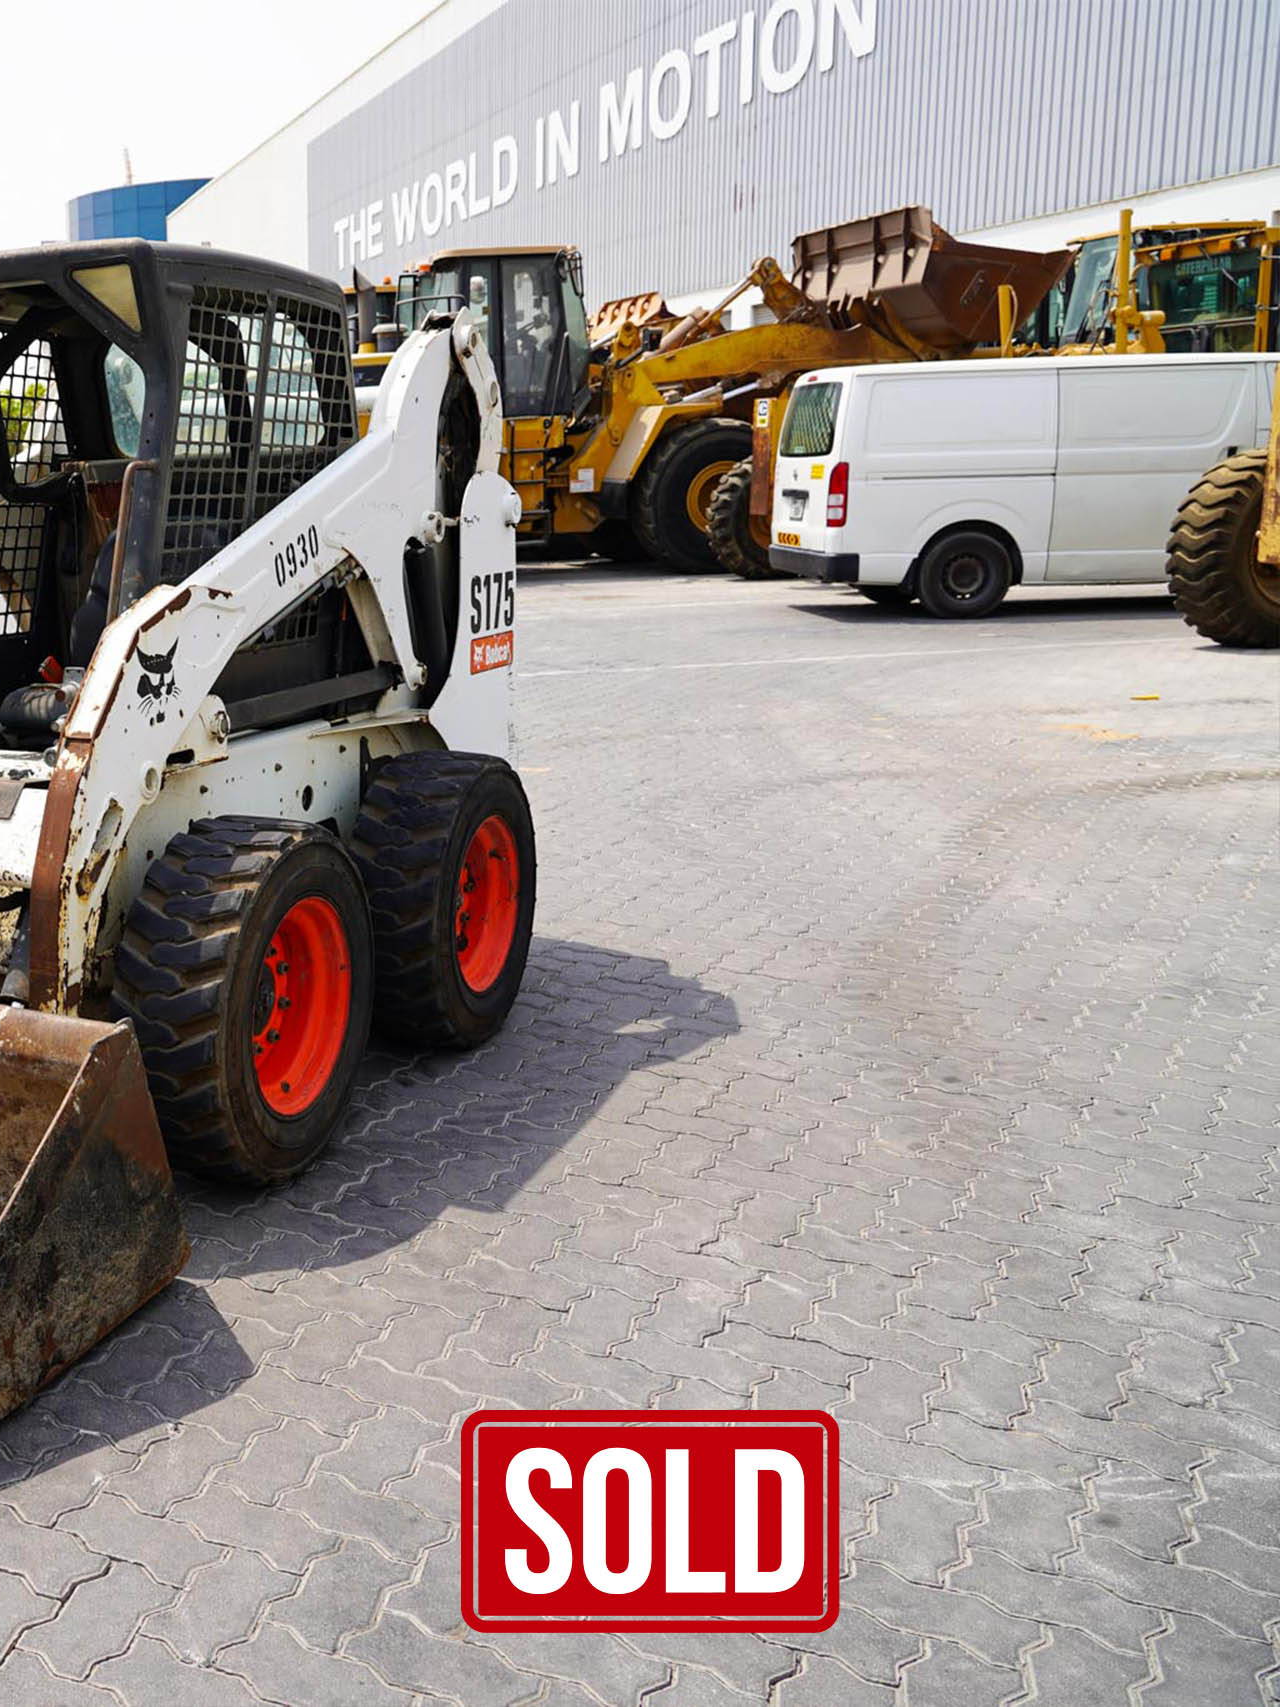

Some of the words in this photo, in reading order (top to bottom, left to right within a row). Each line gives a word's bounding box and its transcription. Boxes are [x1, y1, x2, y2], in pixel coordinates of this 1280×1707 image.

[334, 200, 384, 270] THE
[392, 135, 518, 246] WORLD
[536, 100, 580, 191] IN
[600, 0, 877, 163] MOTION
[274, 524, 319, 587] 0930
[470, 571, 514, 634] S175
[485, 641, 511, 665] Bobcat
